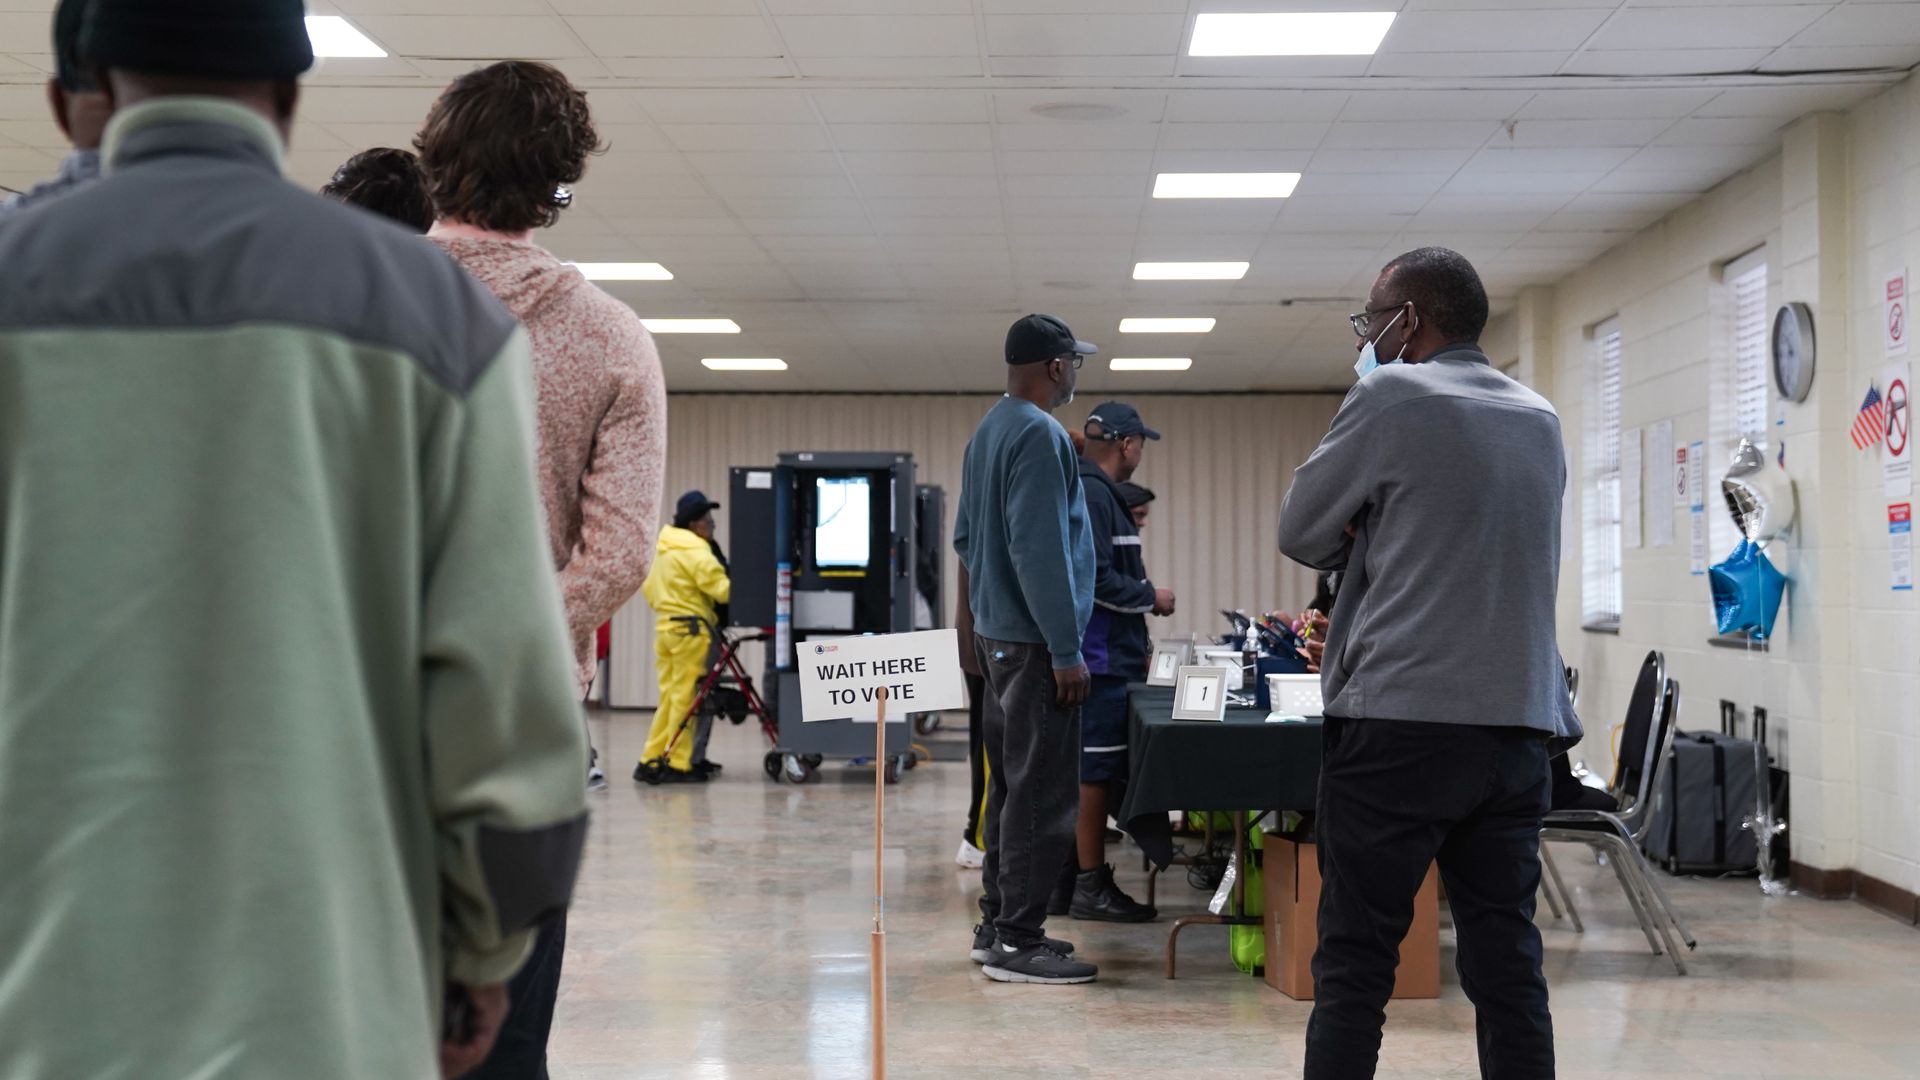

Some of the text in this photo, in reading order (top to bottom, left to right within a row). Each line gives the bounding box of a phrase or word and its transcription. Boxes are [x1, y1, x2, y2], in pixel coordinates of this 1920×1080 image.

[817, 657, 926, 680] WAIT HERE
[828, 688, 856, 705] TO
[1202, 686, 1208, 701] 1
